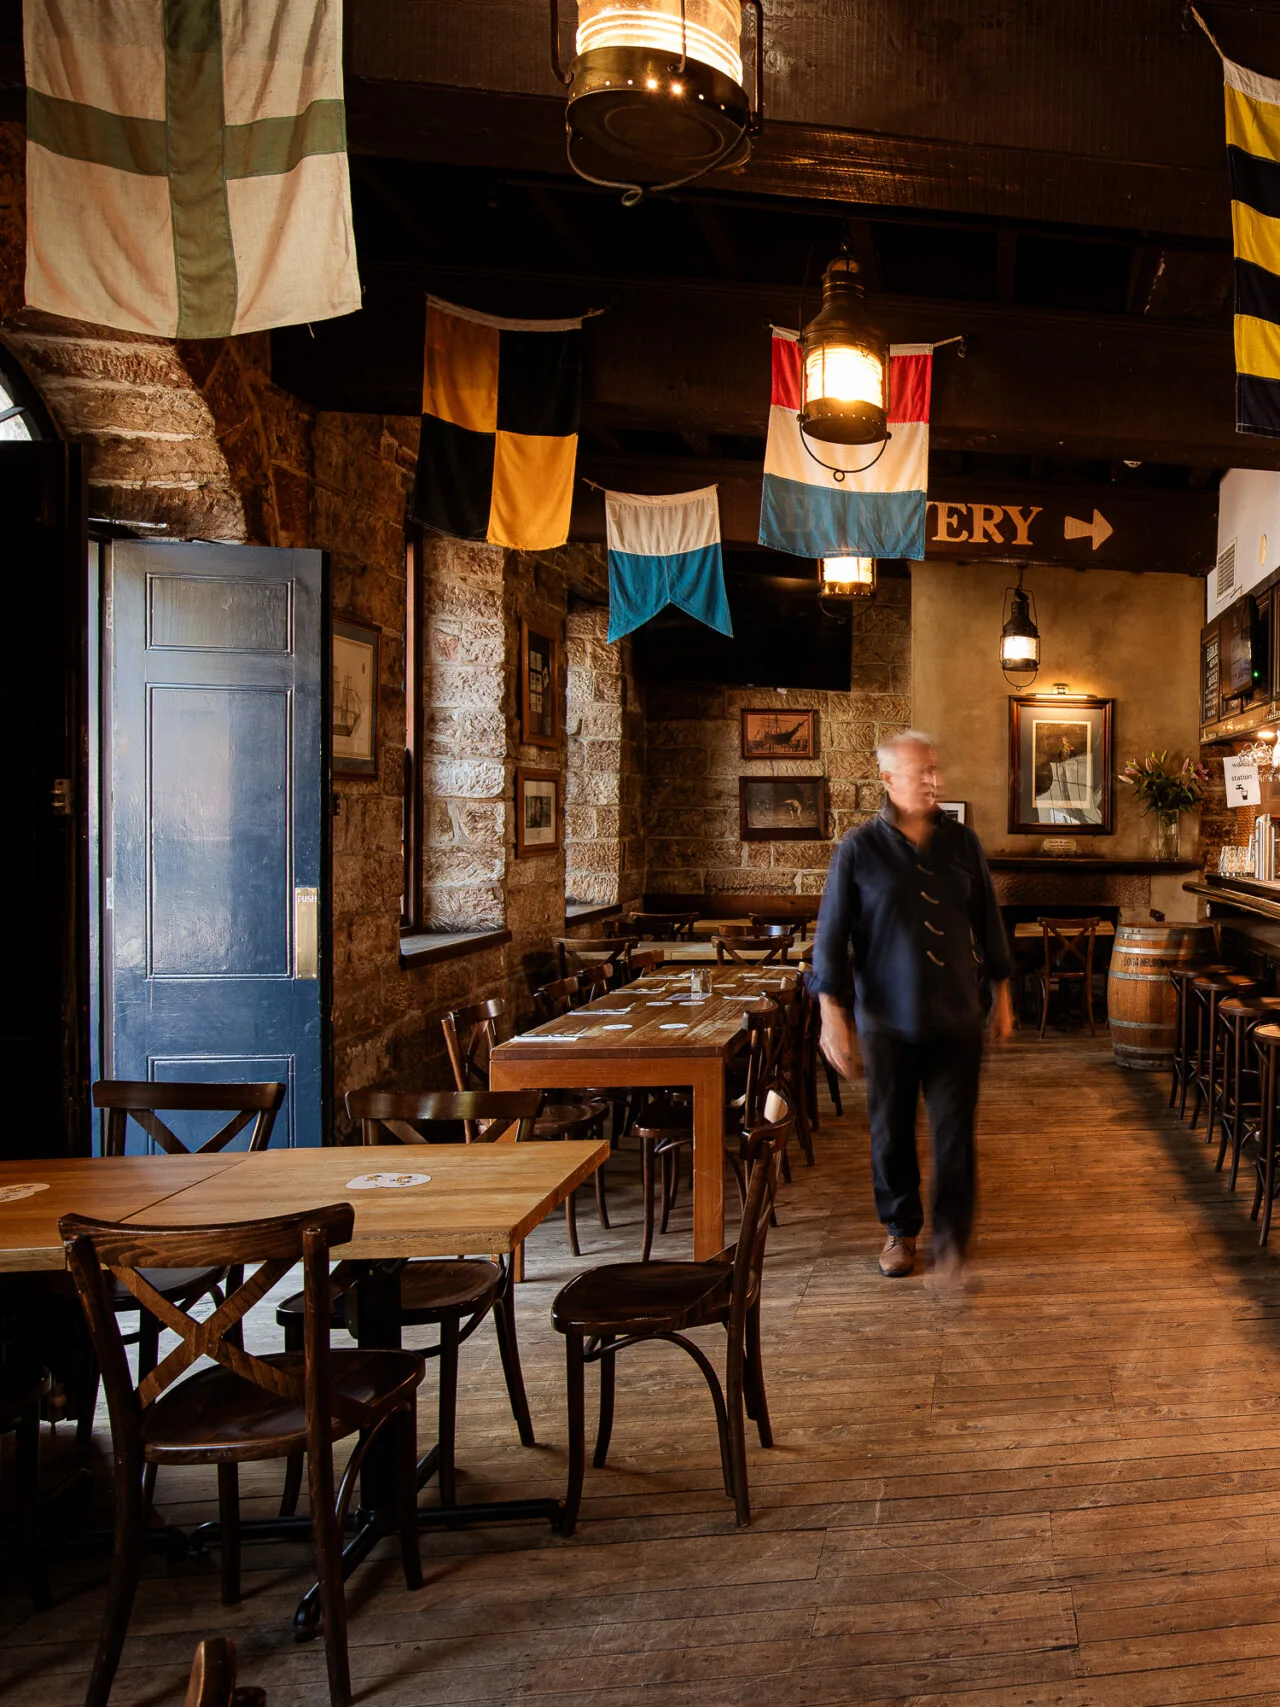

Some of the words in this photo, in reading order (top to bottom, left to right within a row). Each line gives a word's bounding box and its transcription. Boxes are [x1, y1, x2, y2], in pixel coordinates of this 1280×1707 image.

[926, 501, 1043, 546] ERY
[1231, 774, 1253, 782] station
[297, 893, 317, 903] PUSH
